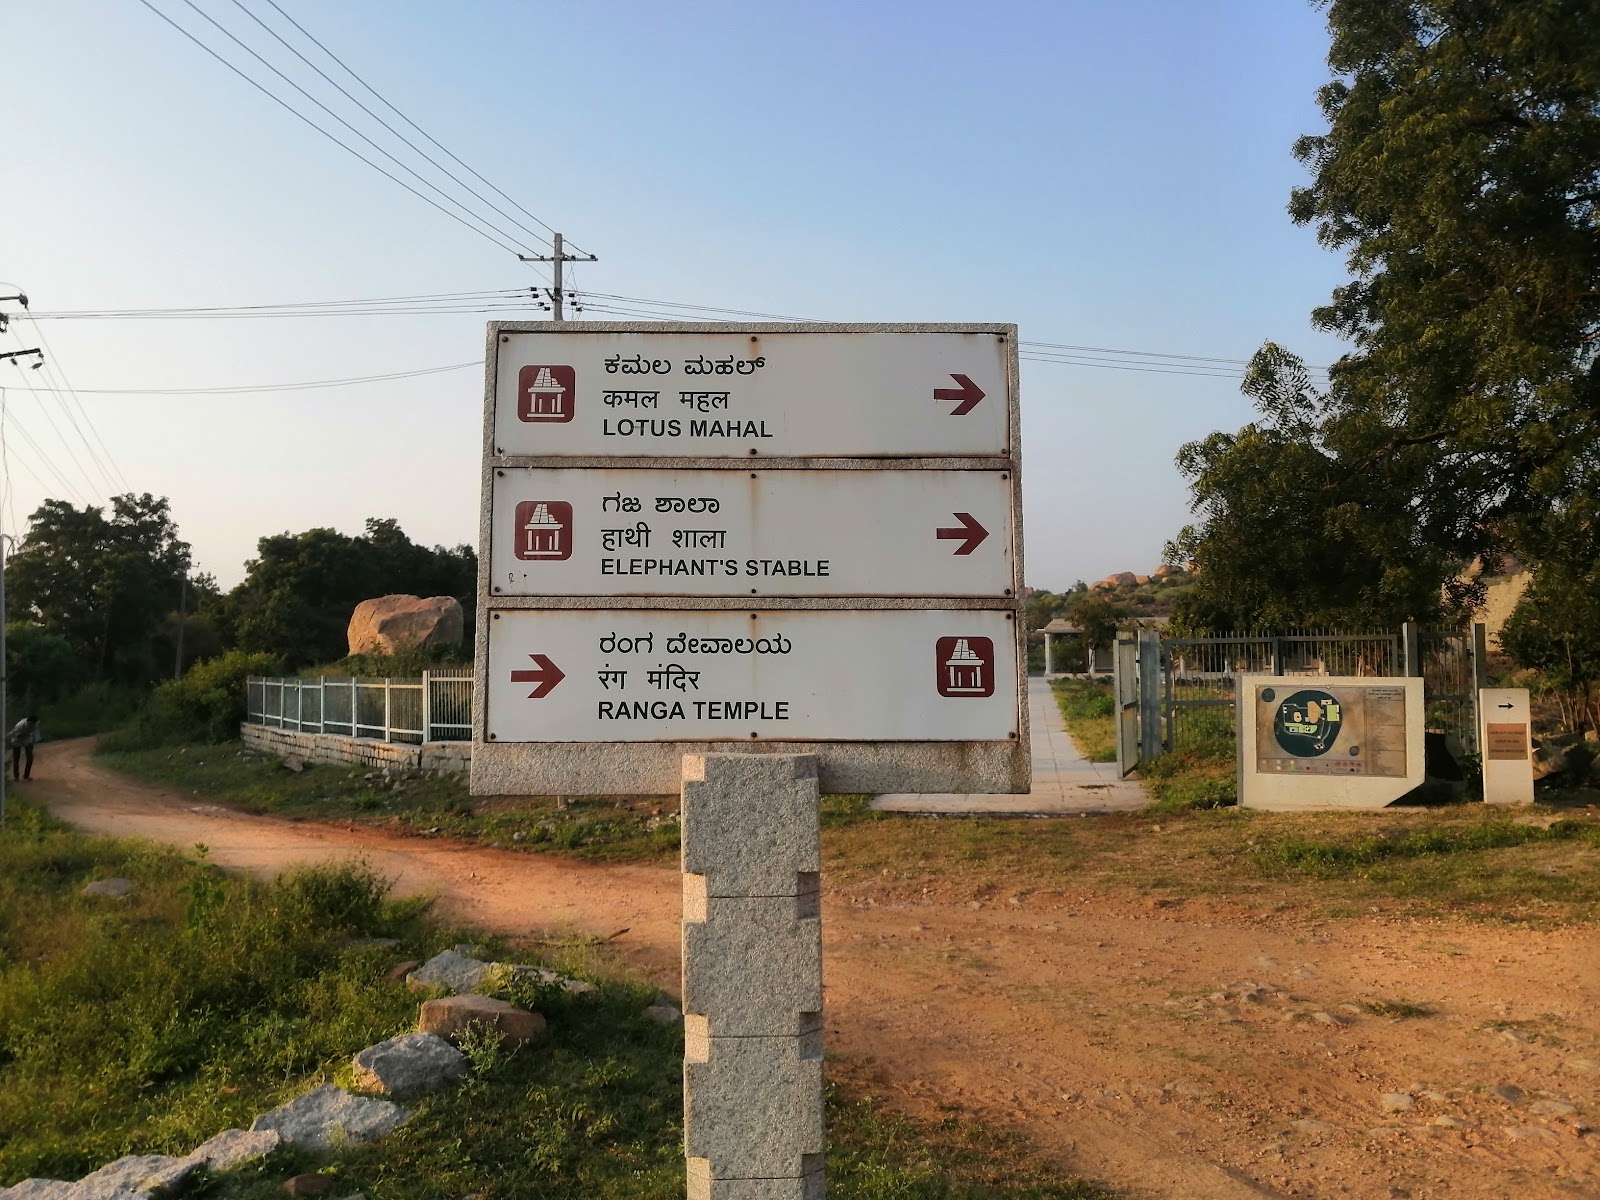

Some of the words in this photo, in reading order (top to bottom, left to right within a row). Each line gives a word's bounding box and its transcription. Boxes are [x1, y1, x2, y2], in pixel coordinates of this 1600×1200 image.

[603, 353, 672, 375] ಕಮಲ
[684, 354, 767, 376] ಮಹಲ್
[602, 389, 661, 409] कमल
[678, 391, 731, 413] महल
[603, 418, 682, 438] LOTUS
[690, 419, 774, 438] MAHAL
[602, 491, 642, 513] ಗಜ
[654, 497, 720, 514] ಶಾಲಾ
[600, 521, 652, 552] हाथी
[671, 529, 727, 549] शाला
[601, 558, 739, 576] ELEPHANT'S
[745, 559, 830, 577] STABLE
[599, 631, 654, 654] ರಂಗ
[666, 631, 792, 655] ದೇವಾಲಯ
[597, 663, 628, 691] रंग
[646, 663, 701, 693] मंदिर
[598, 700, 686, 720] RANGA
[692, 701, 789, 720] TEMPLE
